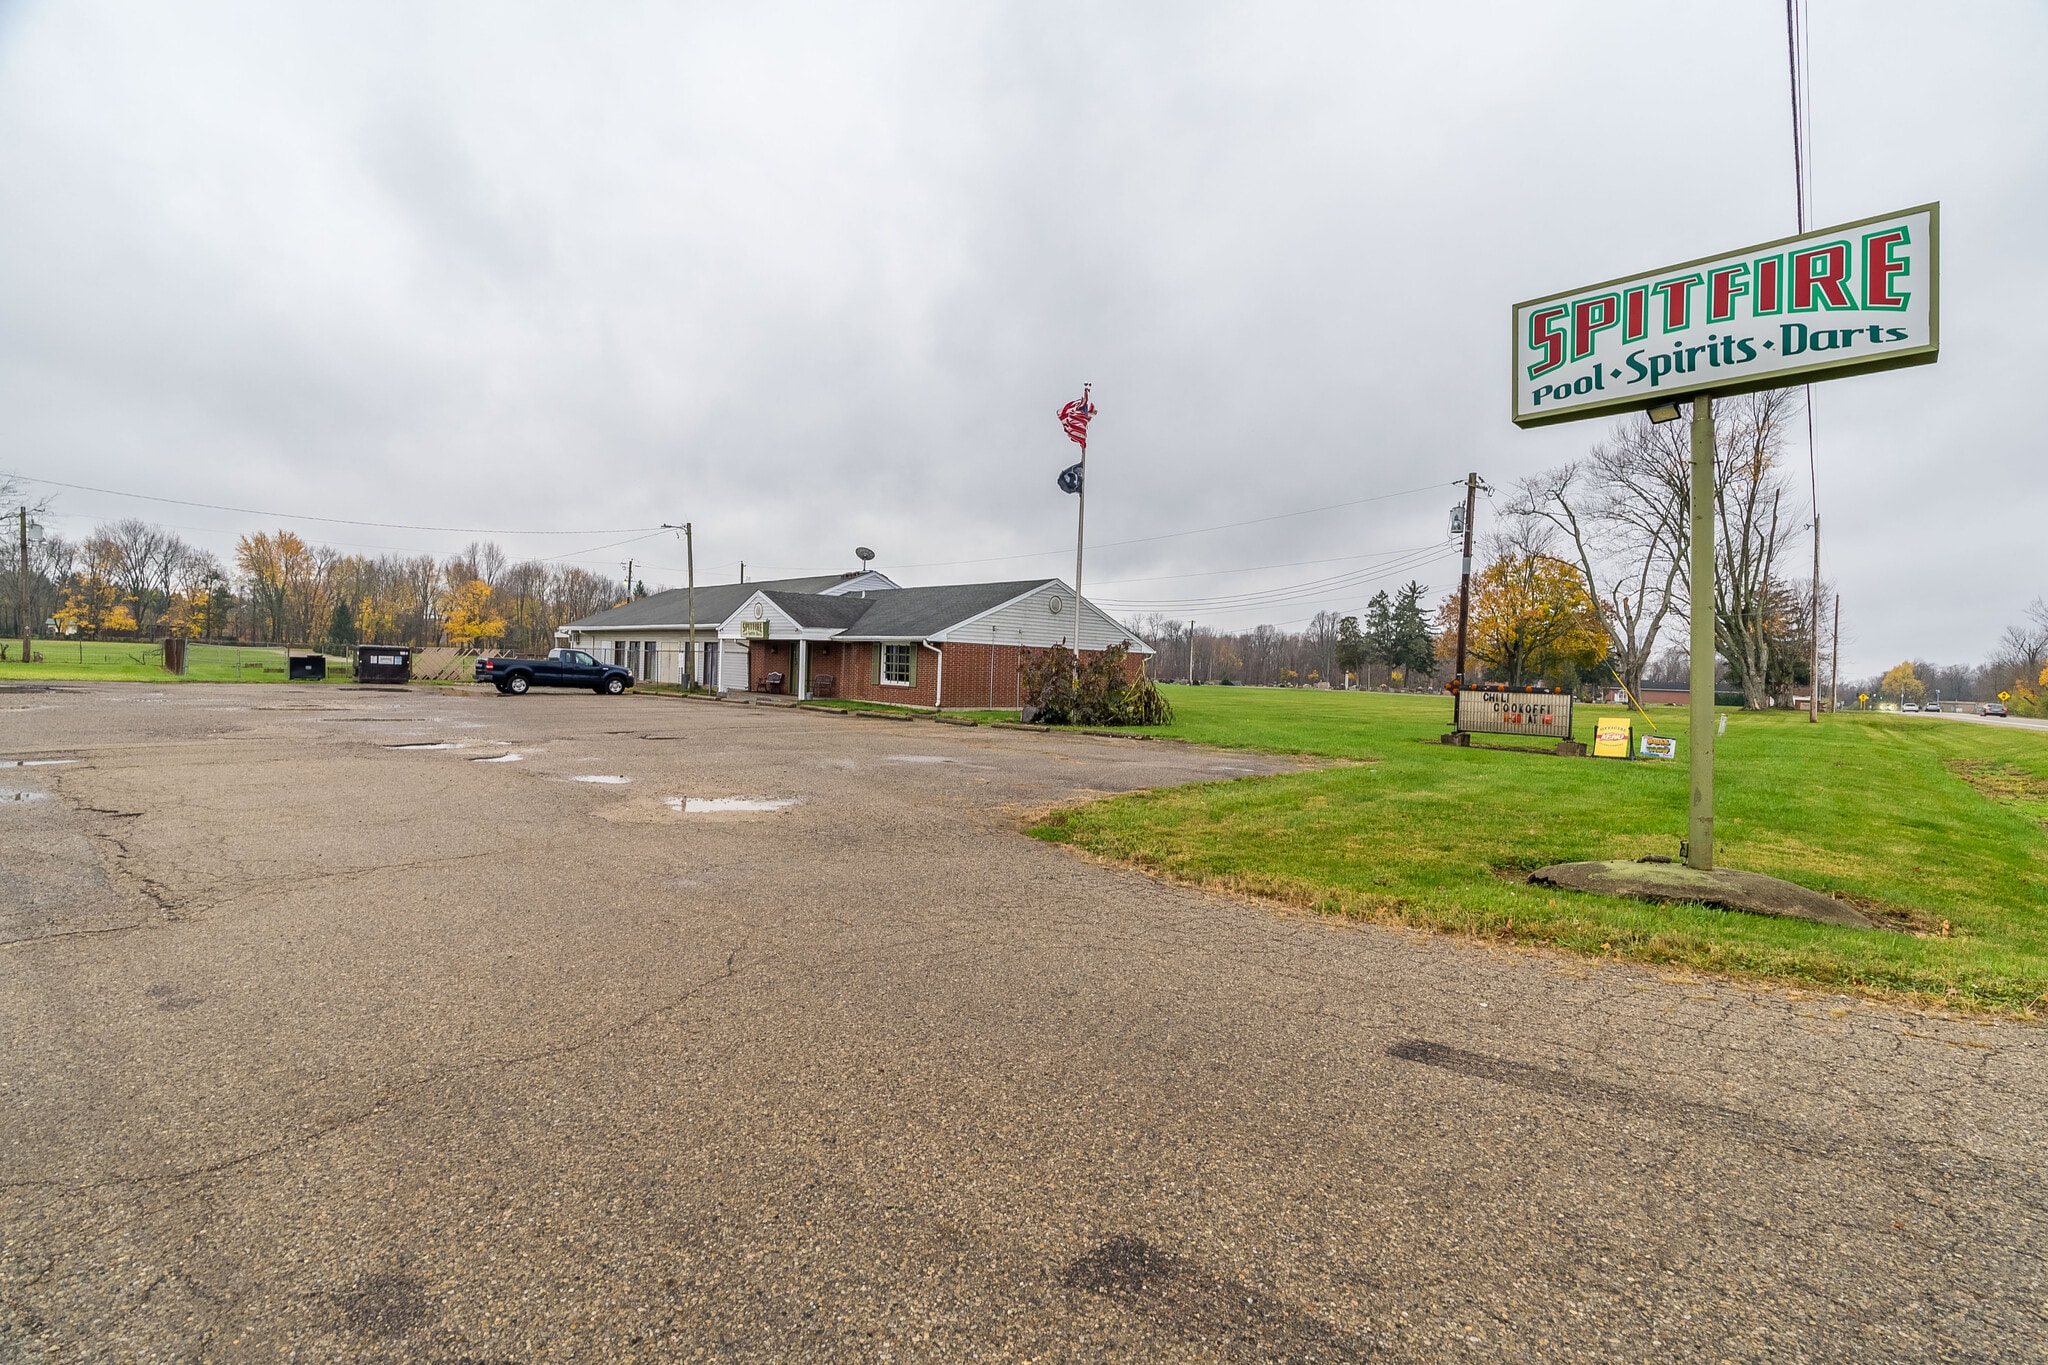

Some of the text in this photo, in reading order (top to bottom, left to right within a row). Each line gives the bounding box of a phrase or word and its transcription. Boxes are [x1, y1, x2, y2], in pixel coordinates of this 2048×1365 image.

[1528, 225, 1911, 380] SPITFIRE
[1531, 323, 1909, 406] Pool Spirits Darts
[1483, 692, 1510, 703] CHILI
[1528, 714, 1537, 724] AT
